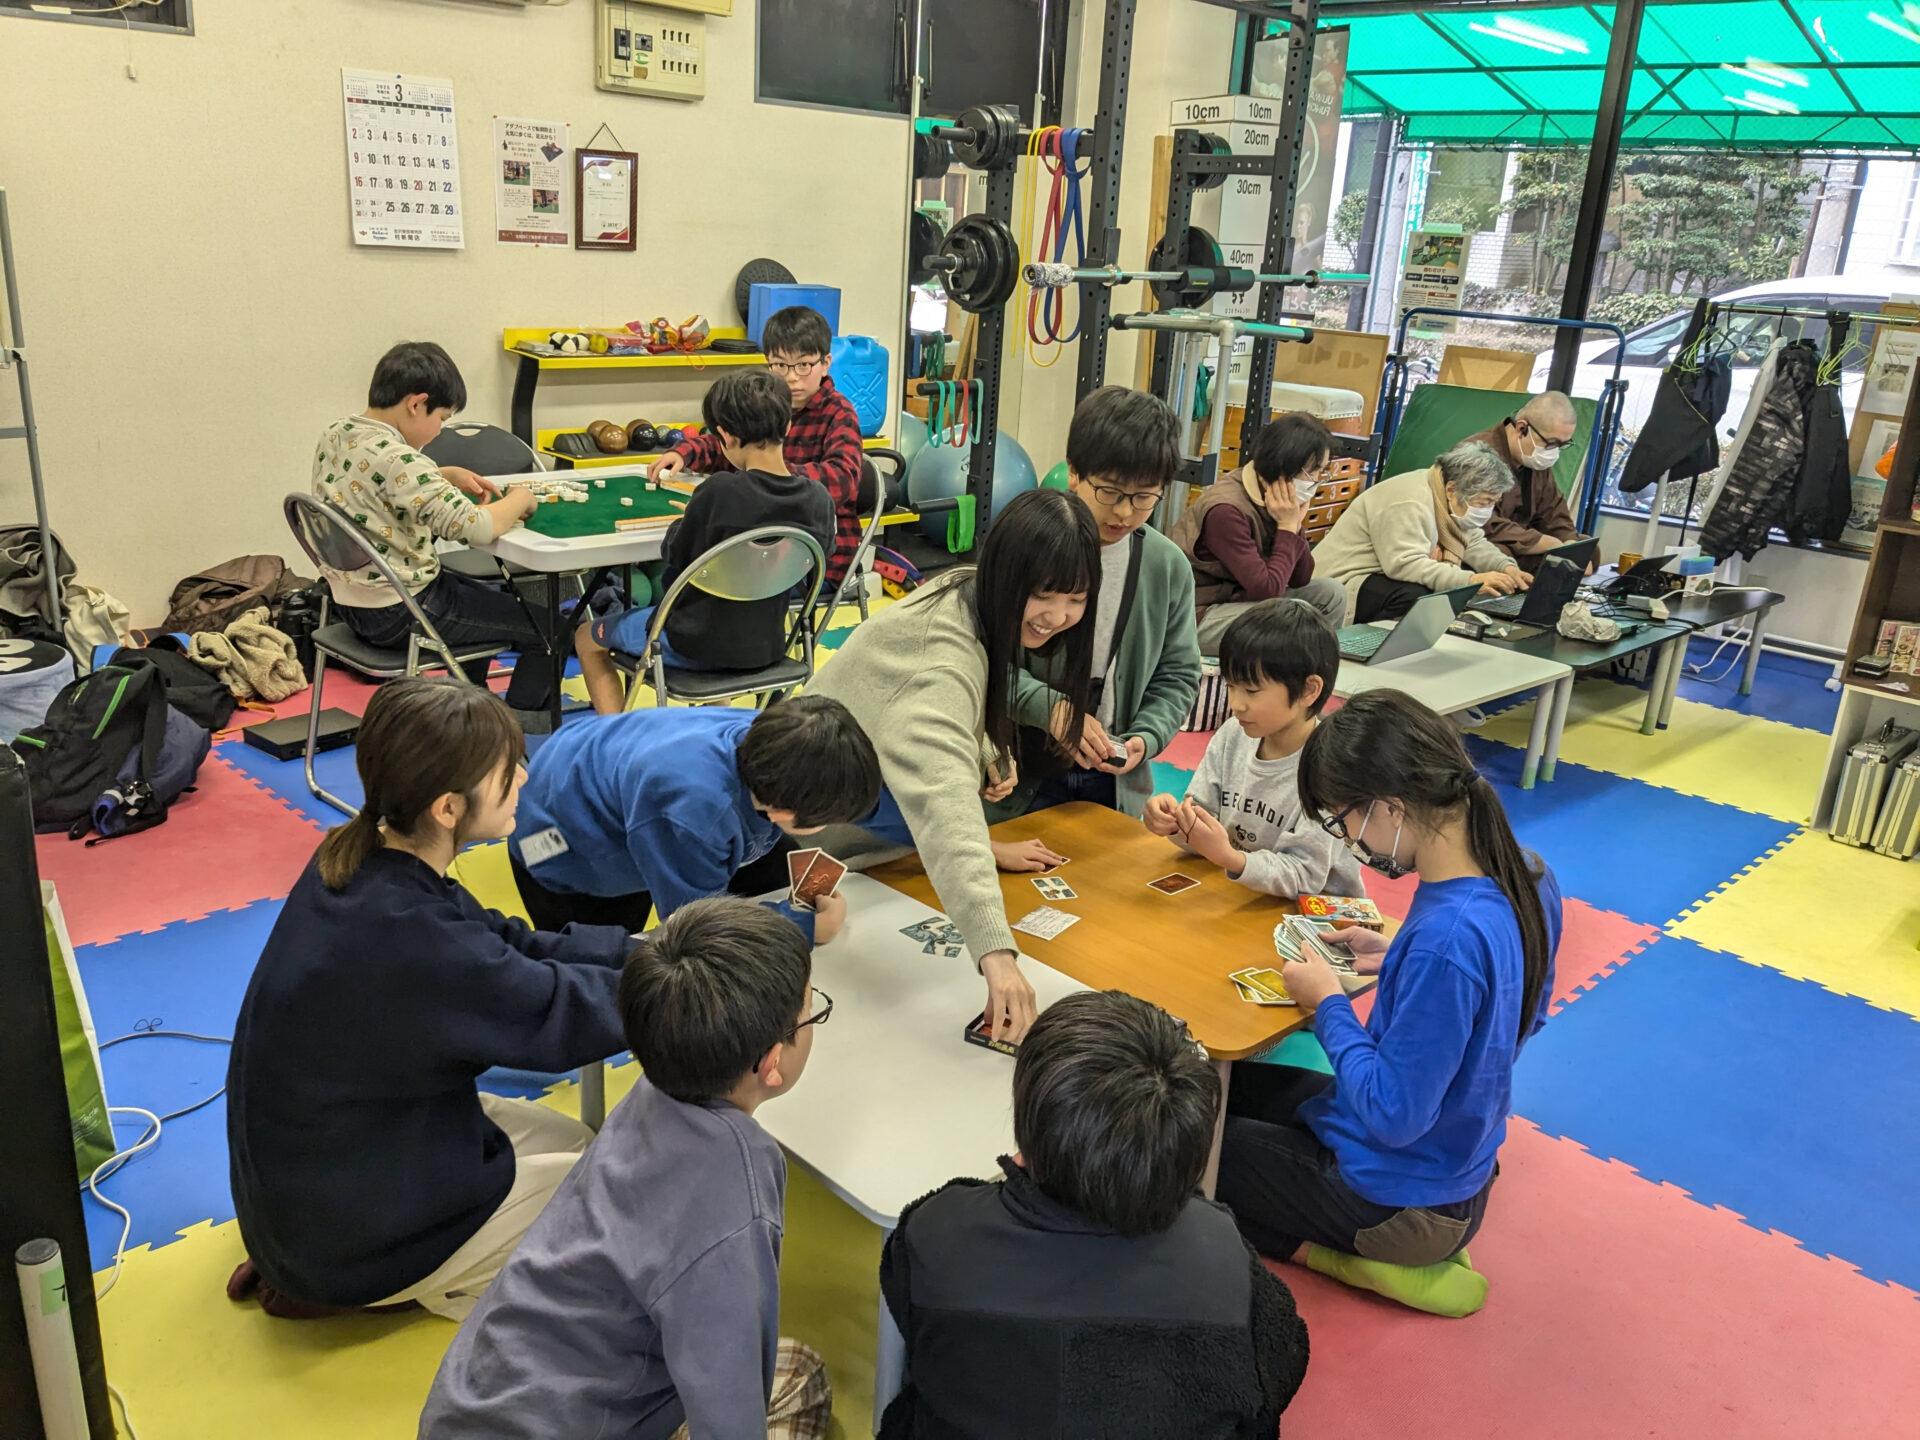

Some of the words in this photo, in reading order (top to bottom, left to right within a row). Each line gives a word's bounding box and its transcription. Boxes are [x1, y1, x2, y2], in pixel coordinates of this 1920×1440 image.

[395, 84, 403, 101] 3
[440, 113, 444, 123] 1
[1185, 104, 1220, 120] 10cm
[1248, 102, 1272, 119] 10cm
[352, 128, 357, 139] 2
[367, 129, 373, 141] 3
[382, 131, 388, 141] 4
[397, 132, 403, 143] 5
[412, 133, 418, 144] 6
[427, 135, 432, 145] 7
[441, 136, 447, 146] 8
[1244, 129, 1270, 146] 20cm
[354, 152, 359, 163] 9
[368, 153, 376, 164] 10
[382, 154, 390, 165] 11
[397, 156, 406, 167] 12
[412, 157, 421, 168] 13
[427, 158, 436, 169] 14
[442, 159, 450, 170] 15
[355, 176, 363, 187] 16
[369, 177, 377, 188] 17
[384, 178, 393, 189] 18
[399, 179, 408, 190] 19
[414, 180, 423, 191] 20
[428, 181, 437, 192] 21
[443, 182, 452, 193] 22
[1236, 178, 1261, 195] 30cm
[386, 201, 395, 212] 25
[401, 202, 410, 213] 26
[415, 203, 424, 214] 27
[430, 204, 439, 215] 28
[445, 205, 454, 215] 29
[1229, 249, 1254, 264] 40cm
[1332, 462, 1340, 476] 2
[1329, 485, 1337, 499] 3
[1326, 507, 1333, 521] 4
